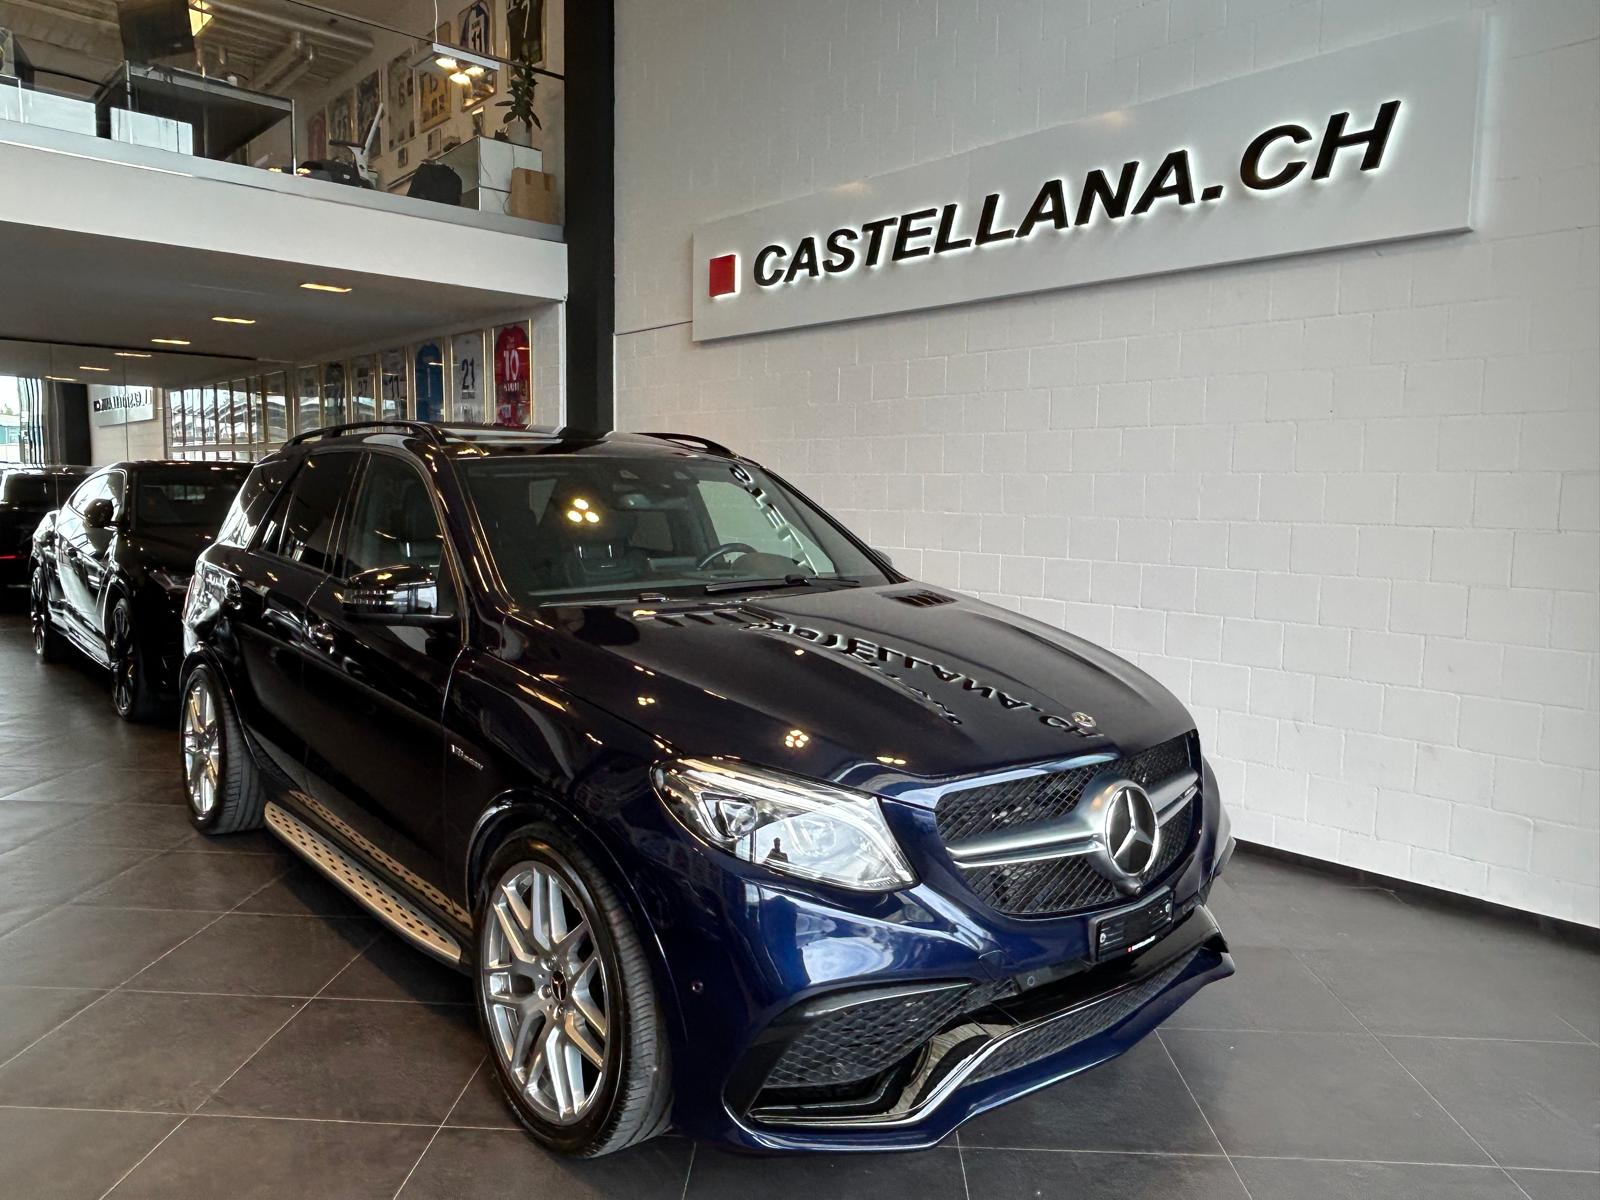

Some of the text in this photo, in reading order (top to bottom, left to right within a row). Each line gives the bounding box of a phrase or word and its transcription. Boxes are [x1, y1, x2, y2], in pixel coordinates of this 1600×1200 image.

[753, 100, 1402, 288] CASTELLANA.CH
[461, 357, 475, 390] 21
[503, 349, 519, 381] 10
